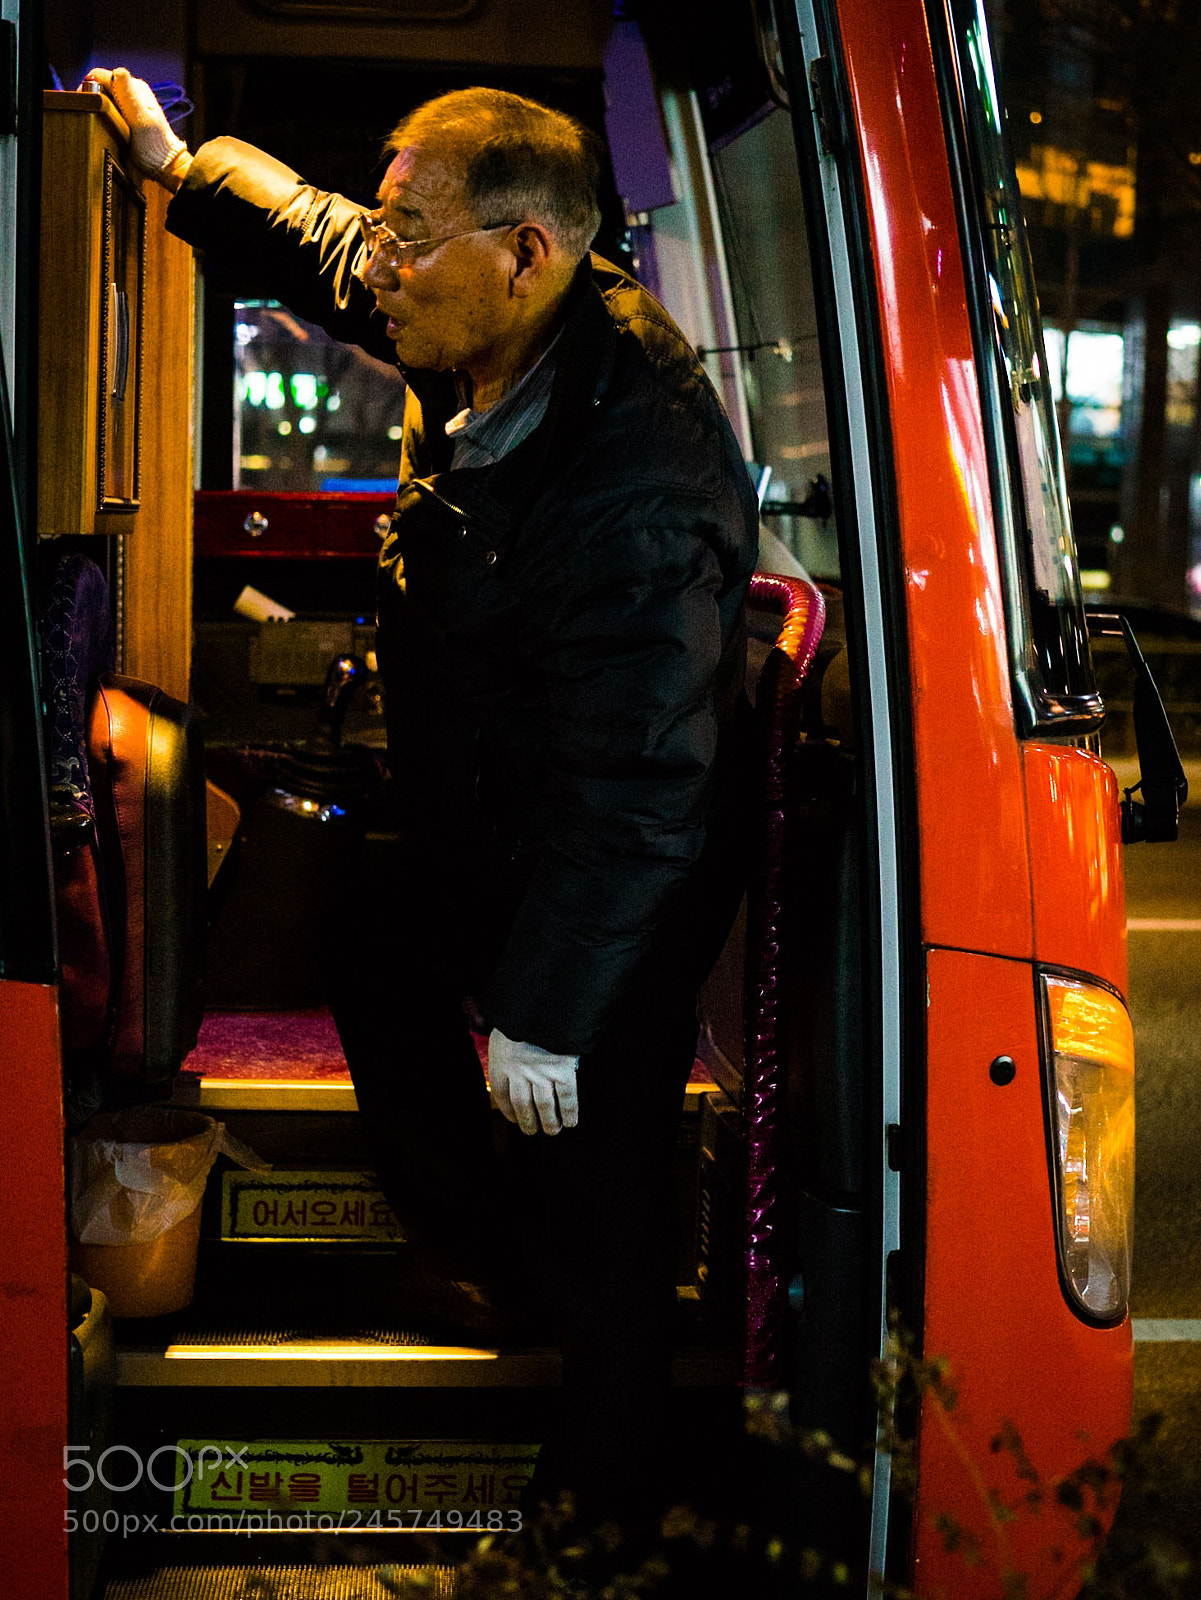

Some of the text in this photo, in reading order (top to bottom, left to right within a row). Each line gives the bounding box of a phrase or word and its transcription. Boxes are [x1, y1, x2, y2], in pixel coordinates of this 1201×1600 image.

[253, 1200, 396, 1227] 어서오세요
[210, 1471, 531, 1504] 신발을 털어주세요
